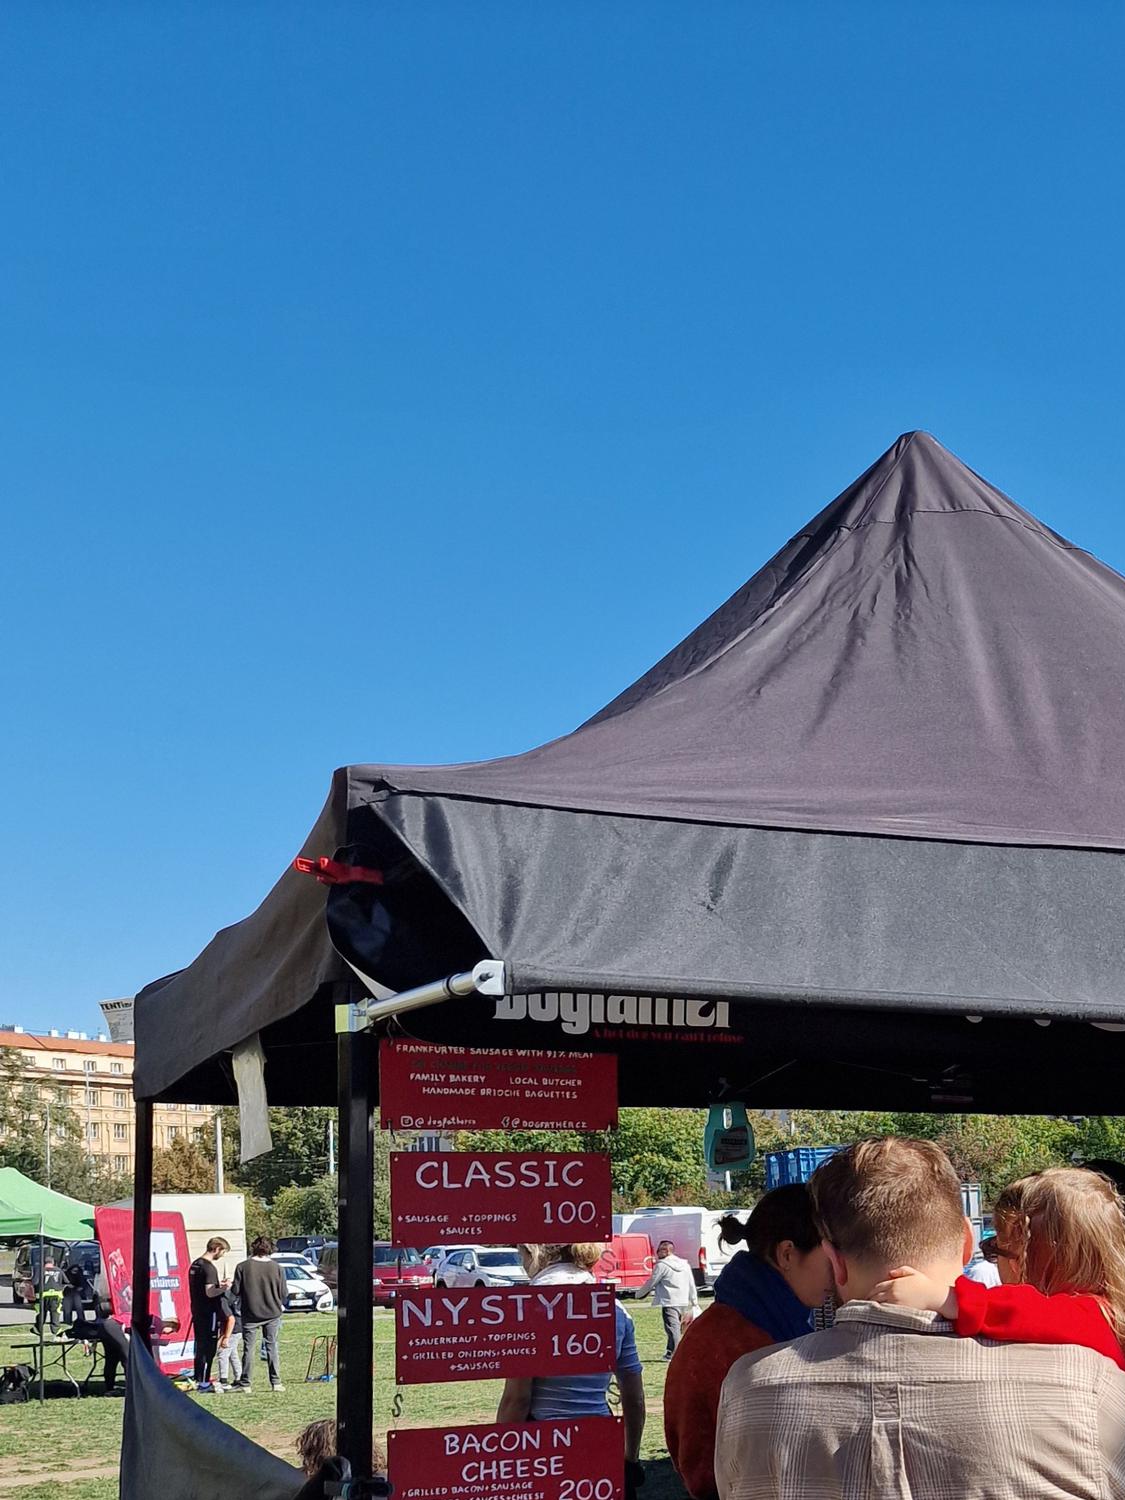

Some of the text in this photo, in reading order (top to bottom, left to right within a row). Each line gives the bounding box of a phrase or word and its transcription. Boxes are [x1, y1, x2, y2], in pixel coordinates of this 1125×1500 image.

[396, 1045, 465, 1054] FRANKFURTER
[470, 1047, 513, 1056] SAUSAGE
[516, 1049, 545, 1057] WITH
[547, 1050, 566, 1058] 91%
[410, 1073, 486, 1083] FAMILY BAKERY
[510, 1077, 582, 1086] LOCAL BUTCHER
[422, 1087, 578, 1099] HANDMADE BRIOCHE BAGUETTES
[416, 1161, 584, 1188] CLASSIC
[444, 1429, 541, 1456] BACON
[461, 1456, 564, 1482] CHEESE
